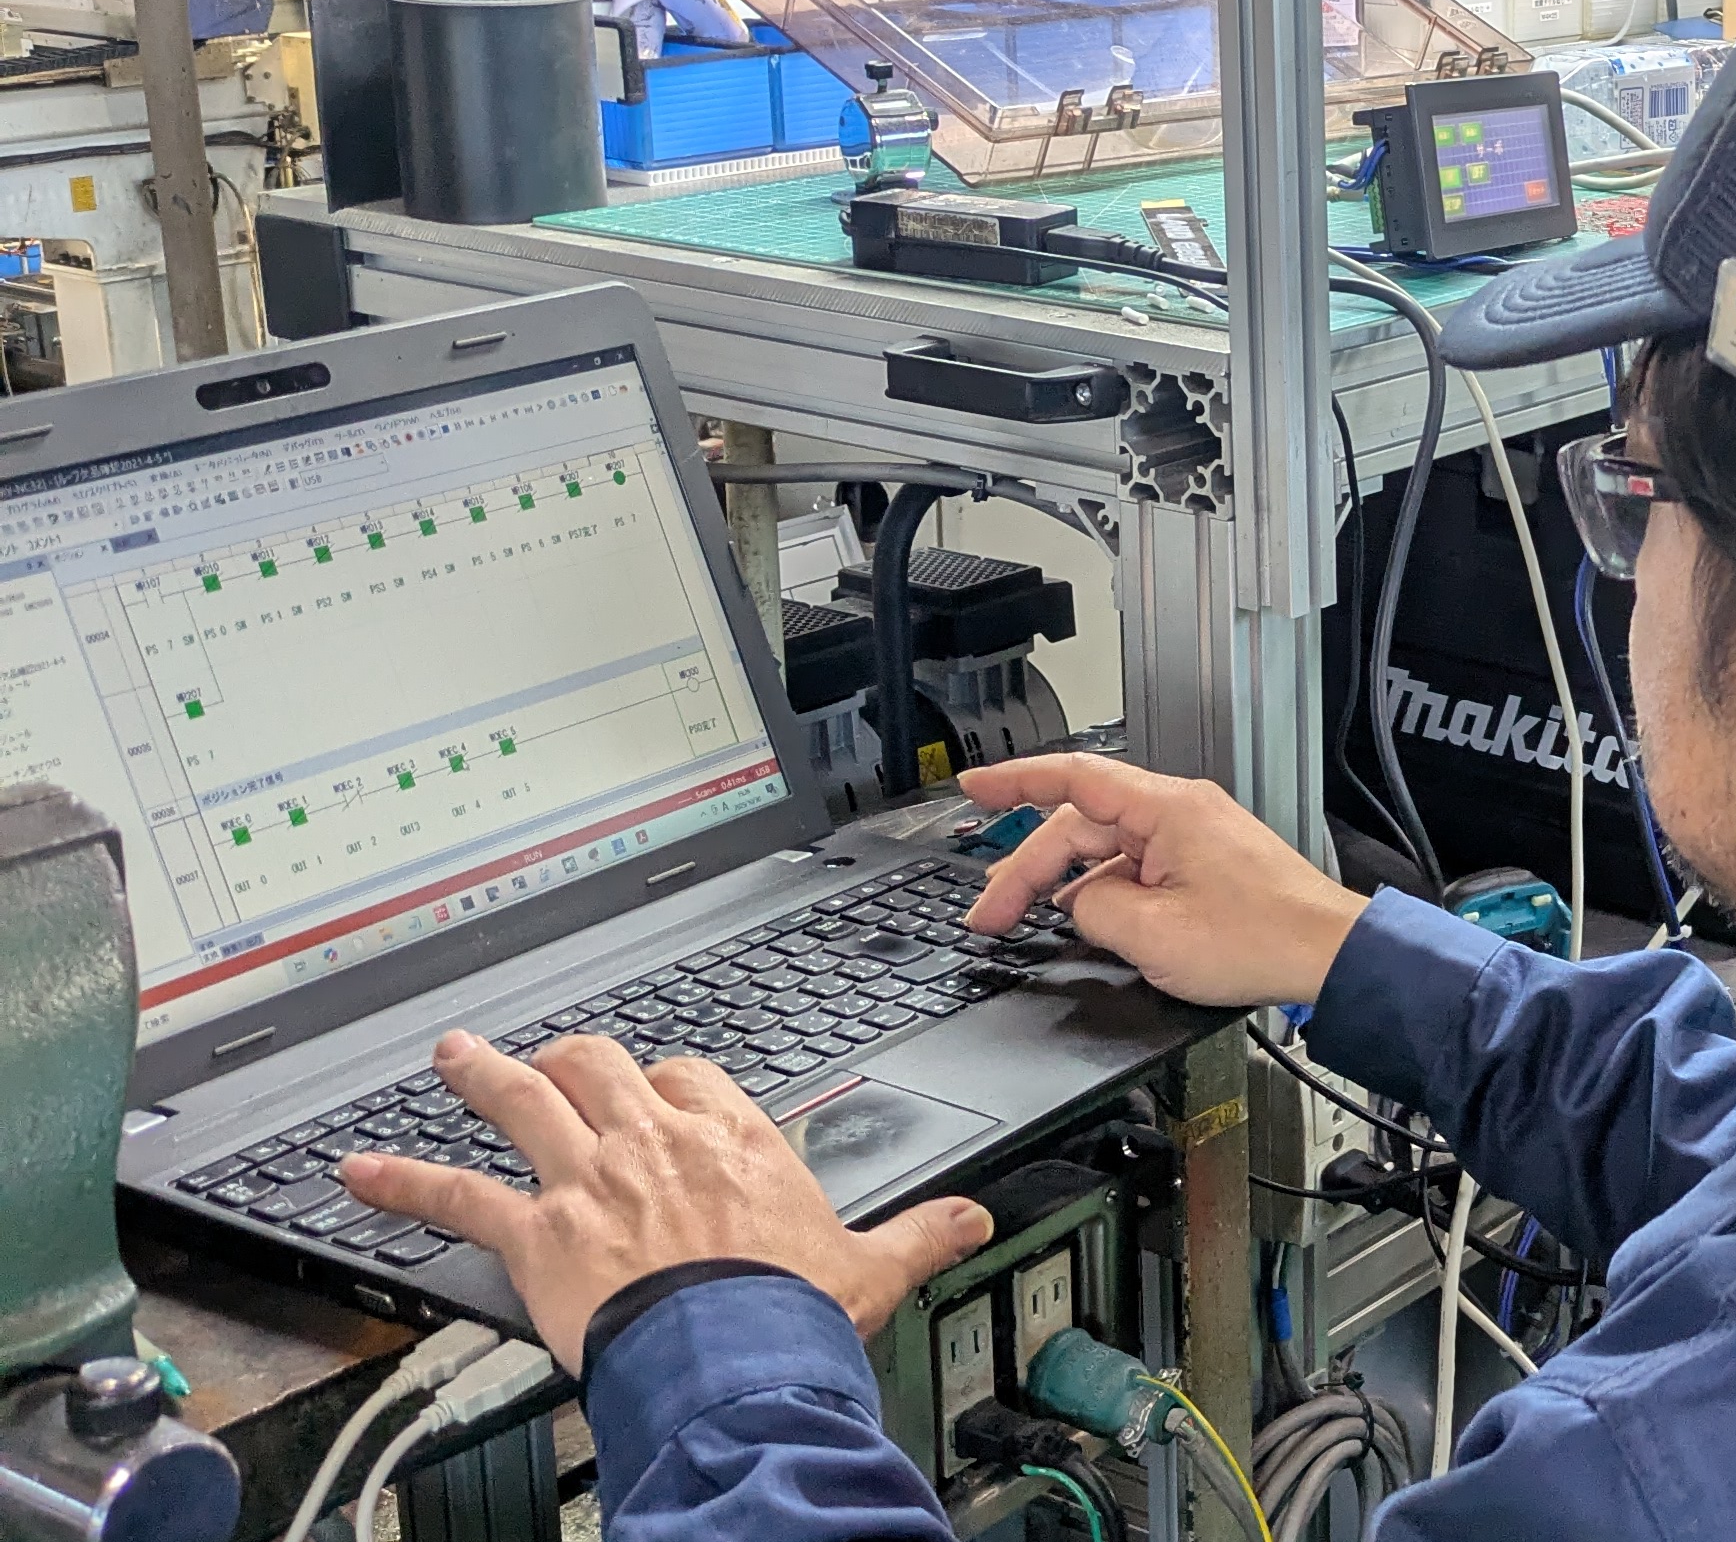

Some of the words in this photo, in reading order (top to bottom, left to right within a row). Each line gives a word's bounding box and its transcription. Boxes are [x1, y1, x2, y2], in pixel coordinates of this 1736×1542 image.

[304, 474, 323, 487] USB
[614, 516, 625, 528] PS
[521, 542, 532, 554] PS
[472, 555, 484, 567] PS
[421, 567, 438, 580] PS4
[369, 582, 387, 594] PS3
[315, 596, 333, 609] PS2
[260, 613, 274, 625] PS
[204, 628, 217, 640] PS
[145, 644, 159, 656] PS
[1387, 666, 1640, 789] makita
[755, 765, 771, 777] USB
[201, 771, 284, 805] ポジション完了信号
[502, 787, 517, 800] OUT
[451, 804, 467, 818] OUT
[400, 821, 421, 836] OUT3
[346, 841, 362, 855] OUT
[370, 836, 377, 846] 2
[523, 850, 543, 864] RUN
[291, 860, 308, 874] OUT
[234, 880, 251, 894] OUT
